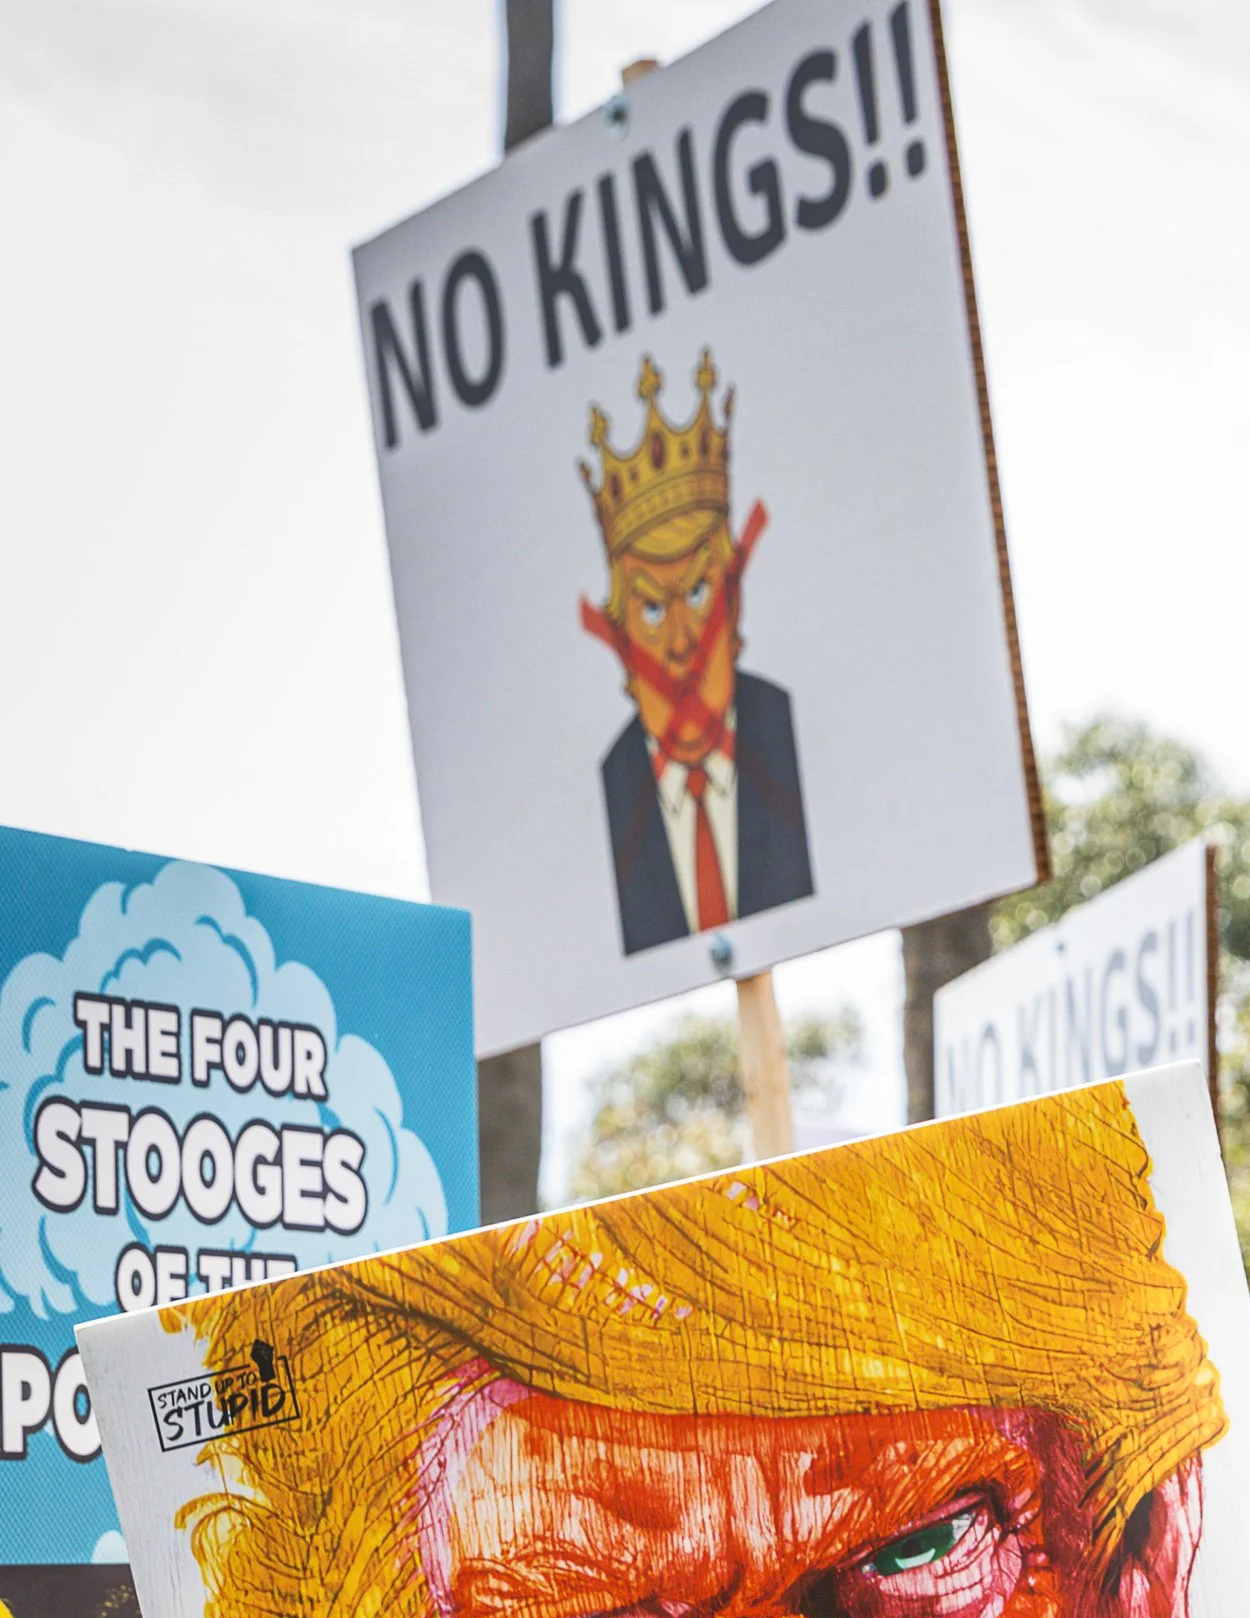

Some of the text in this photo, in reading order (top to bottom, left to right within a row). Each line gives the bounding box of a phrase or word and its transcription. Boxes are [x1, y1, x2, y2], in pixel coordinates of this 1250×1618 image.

[368, 3, 926, 451] NO KINGS!!
[73, 992, 328, 1101] THE FOUR
[33, 1096, 368, 1235] STOOGES
[117, 1240, 189, 1311] OF
[157, 1371, 257, 1409] STAND UP TO
[163, 1383, 287, 1442] STUPID
